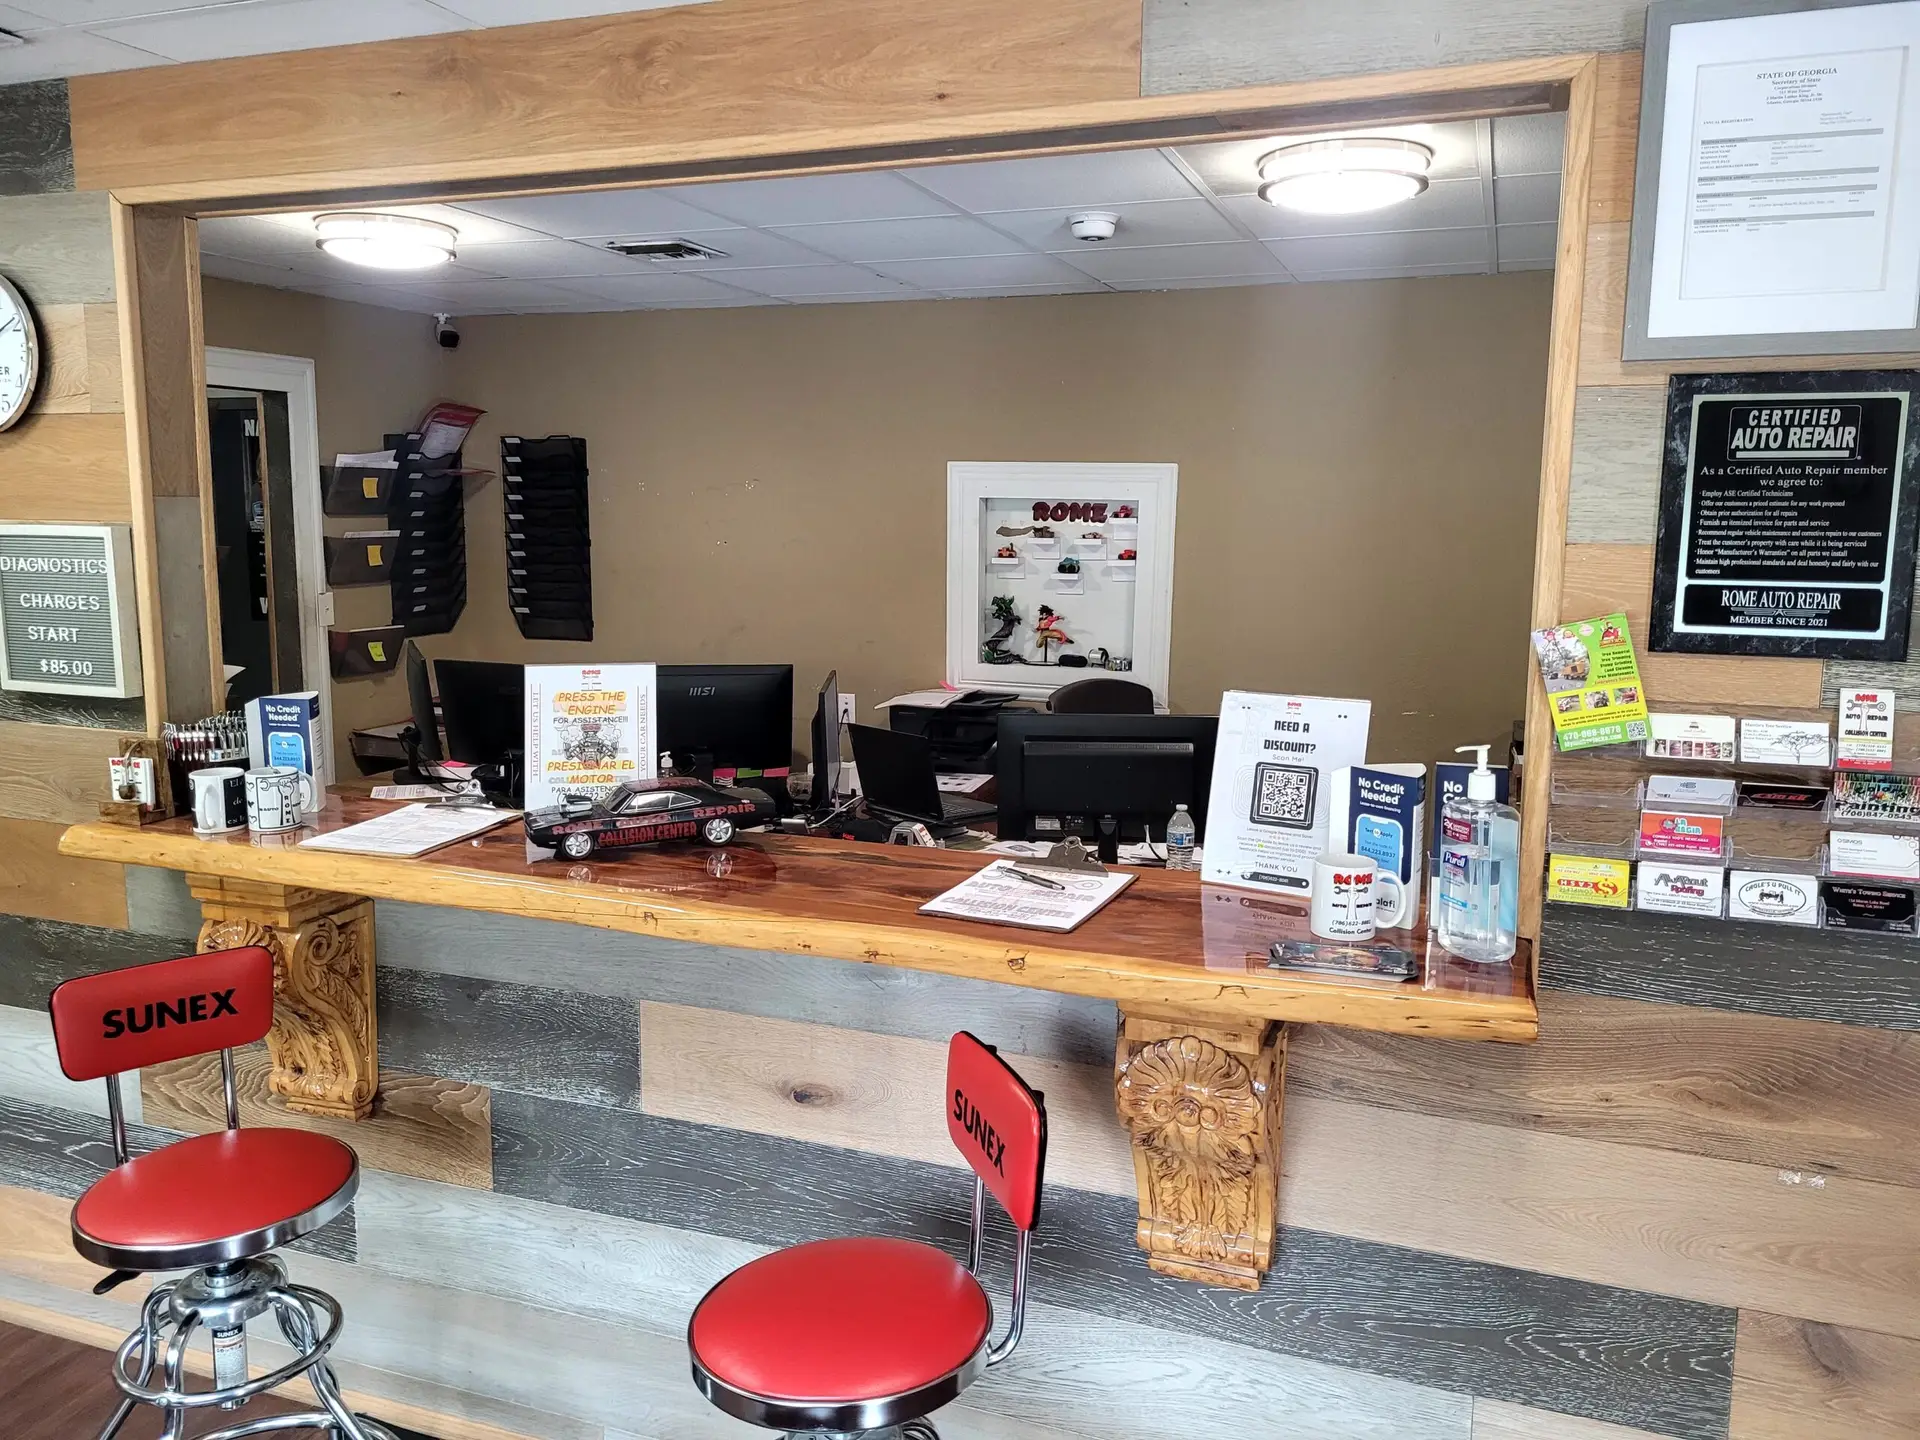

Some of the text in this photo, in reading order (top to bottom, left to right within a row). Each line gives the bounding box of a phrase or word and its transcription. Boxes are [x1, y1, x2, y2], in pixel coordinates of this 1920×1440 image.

[1756, 67, 1838, 80] STATE OF GEORGIA
[12, 313, 21, 332] 2
[15, 373, 23, 387] 4
[2, 394, 11, 413] 5
[1749, 409, 1841, 426] CERTIFIED
[1731, 427, 1856, 449] AUTO REPAIR
[1700, 466, 1715, 475] As
[1727, 465, 1773, 476] Certified
[1775, 465, 1802, 475] Auto
[1805, 465, 1841, 477] Repair
[1843, 465, 1888, 475] member
[1777, 479, 1807, 488] agree
[1809, 478, 1823, 486] to:
[1701, 489, 1723, 498] Employ
[1736, 489, 1761, 497] Certified
[1821, 500, 1846, 508] proposed
[1032, 502, 1108, 524] ROME
[1718, 510, 1731, 518] prior
[1780, 510, 1798, 518] repairs
[1783, 520, 1798, 528] parts
[1827, 540, 1843, 549] being
[1806, 550, 1821, 558] parts
[0, 557, 107, 573] DIAGNOSTICS
[1718, 558, 1731, 567] high
[1730, 559, 1761, 567] professional
[1796, 559, 1808, 567] deal
[1808, 559, 1830, 568] honestly
[1841, 560, 1857, 569] fairly
[20, 593, 100, 610] CHARGES
[1721, 590, 1841, 609] ROME AUTO REPAIR
[1730, 616, 1828, 626] MEMBER SINCE 2021
[28, 626, 80, 643] START
[40, 659, 93, 675] $85.00
[559, 691, 624, 702] PRESS THE
[277, 705, 301, 713] Credit
[568, 705, 616, 715] ENGINE
[533, 711, 539, 723] US
[1867, 714, 1888, 722] REPAIR
[1274, 720, 1310, 733] NEED A
[1845, 729, 1868, 737] COLLISION
[1264, 739, 1316, 754] DISCOUNT?
[622, 760, 635, 769] EL
[569, 774, 614, 783] MOTOR
[1358, 777, 1404, 794] No Credit
[1444, 781, 1463, 793] No
[693, 803, 756, 818] REPAIR
[1841, 810, 1912, 820] (706)847-0543
[598, 821, 697, 847] COLLISION CENTER
[1445, 852, 1466, 868] Purell
[1255, 862, 1279, 871] THANK
[1333, 873, 1373, 885] ROME
[1778, 883, 1793, 892] PULL
[102, 988, 239, 1039] SUNEX
[954, 1089, 1006, 1179] SUNEX
[217, 1329, 238, 1337] SUNEX
